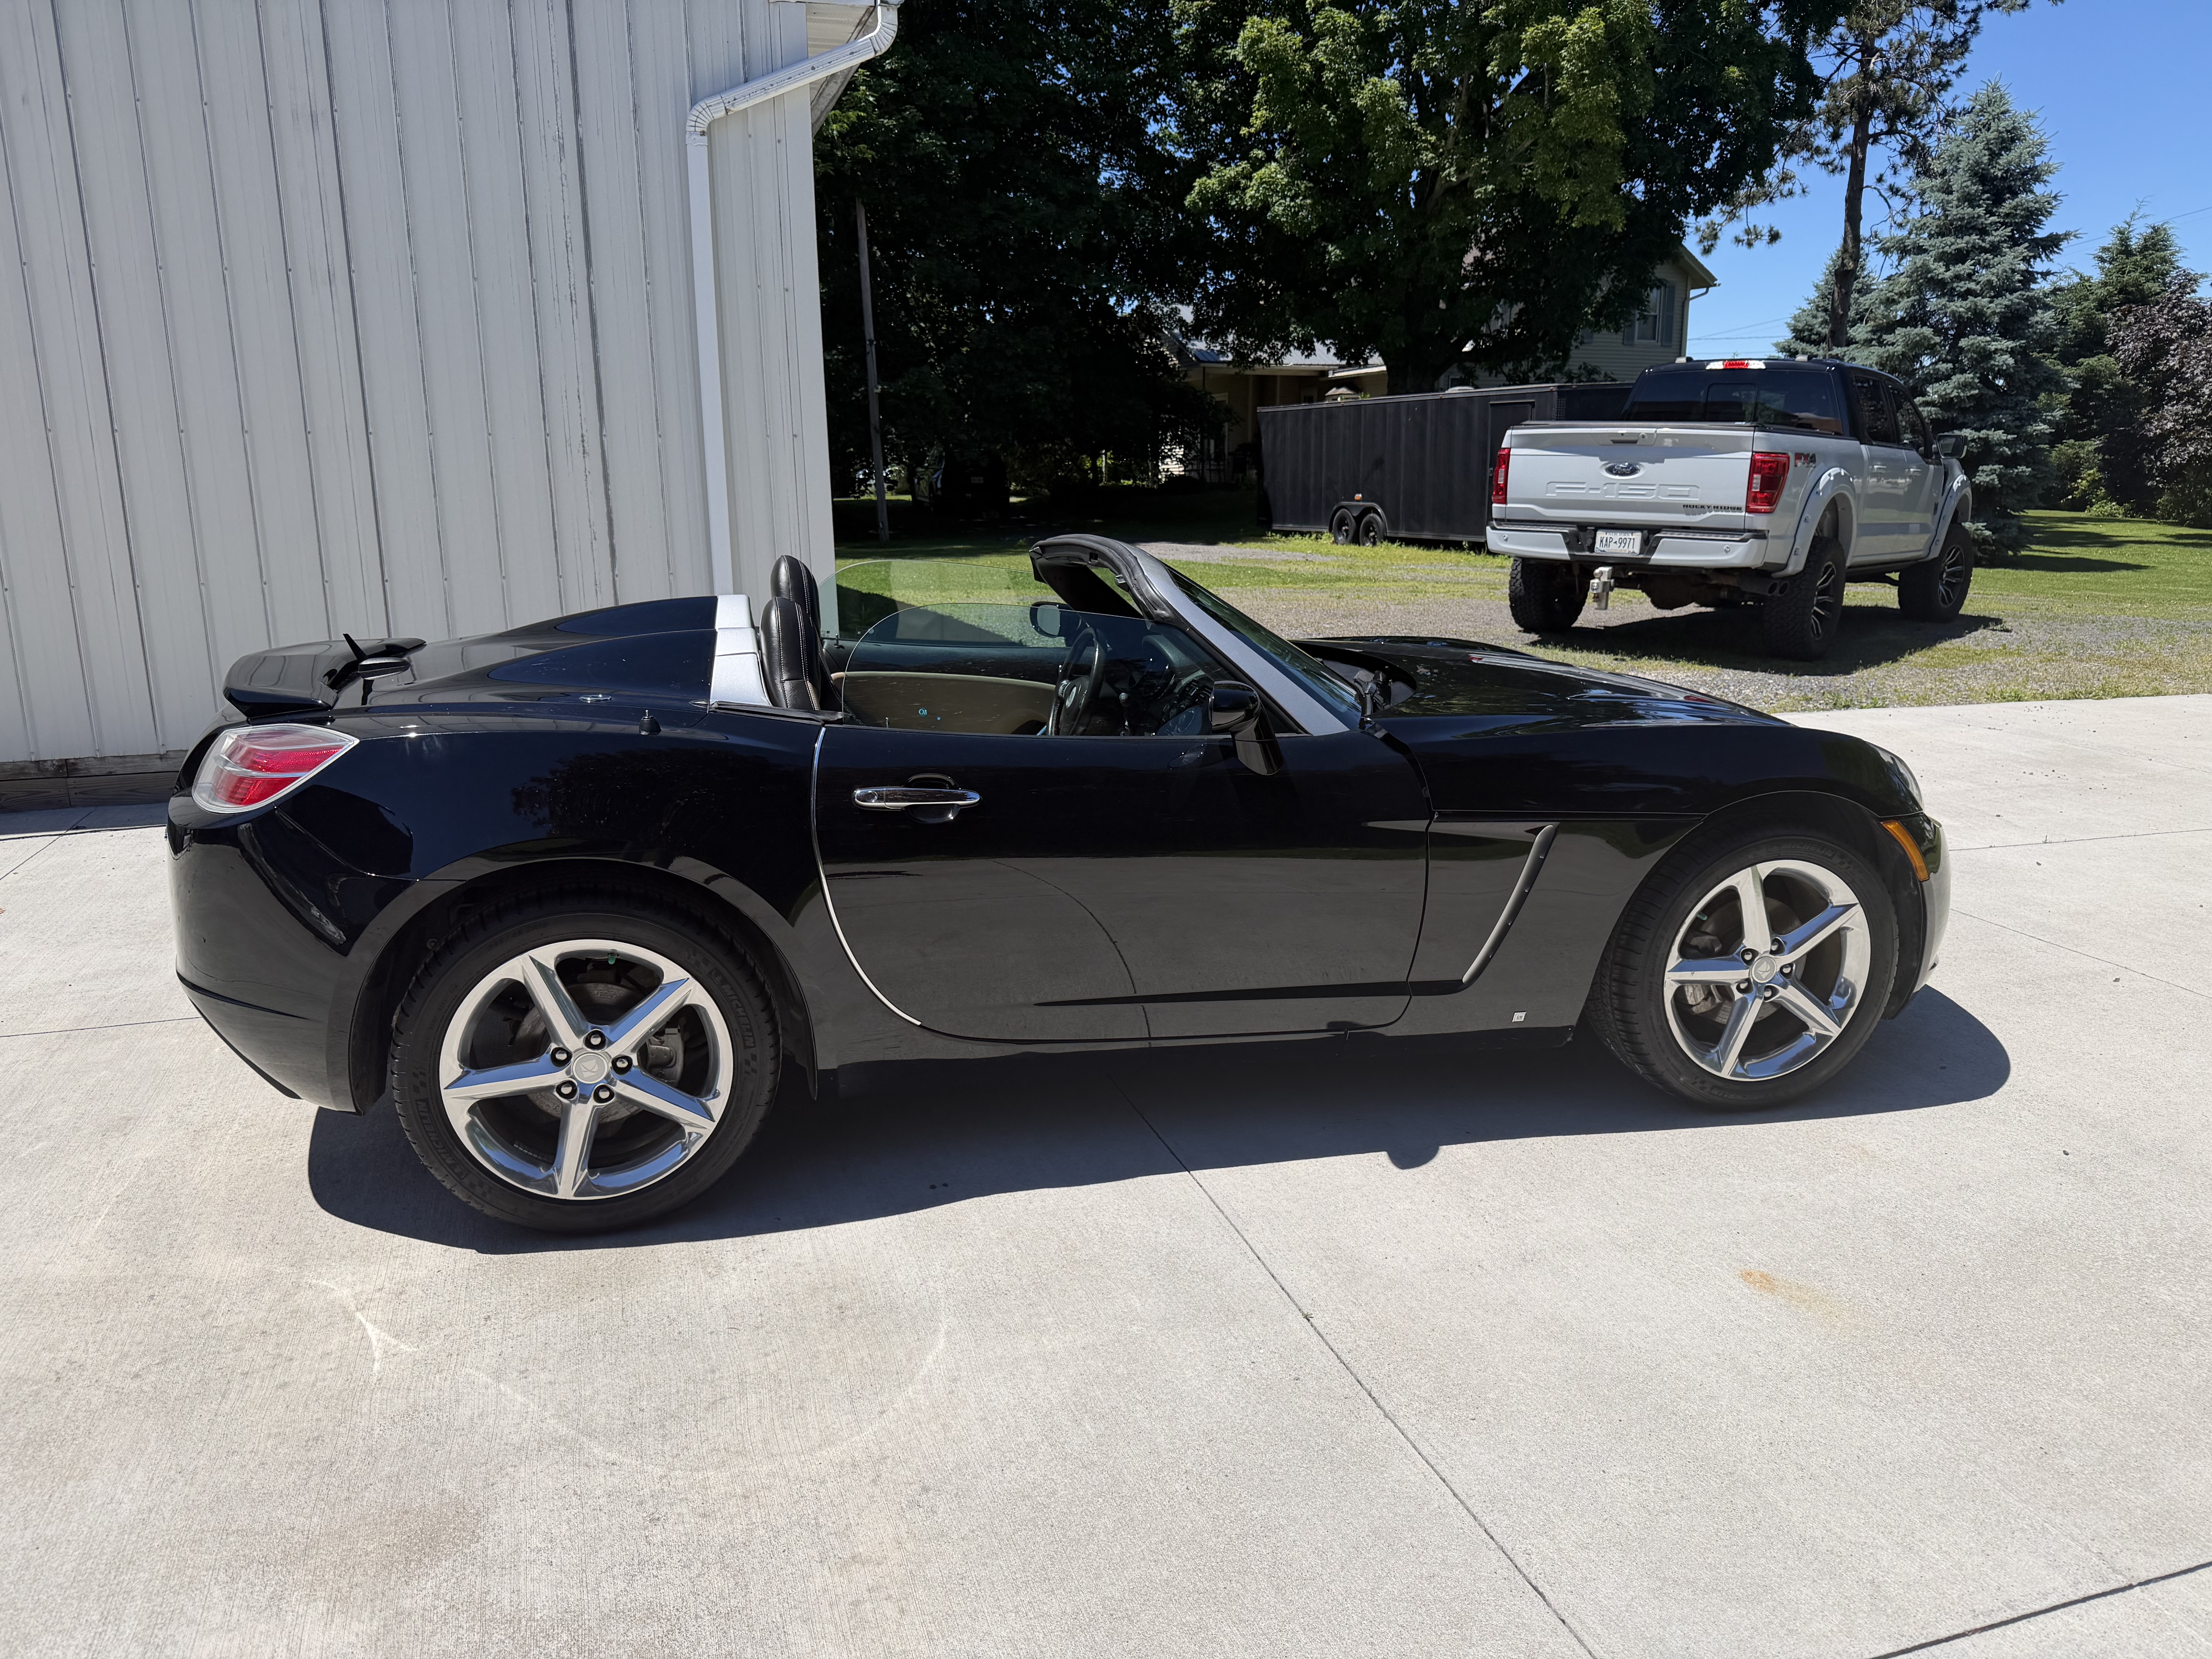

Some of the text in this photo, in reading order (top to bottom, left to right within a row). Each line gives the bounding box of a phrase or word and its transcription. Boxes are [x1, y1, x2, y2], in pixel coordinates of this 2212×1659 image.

[1794, 452, 1816, 467] FX4
[1546, 481, 1700, 501] F-150
[1599, 536, 1635, 549] KAP 9971
[1781, 842, 1836, 857] MICHELIN
[721, 984, 755, 1048] MICHELIN
[417, 1100, 457, 1165] MICHELIN
